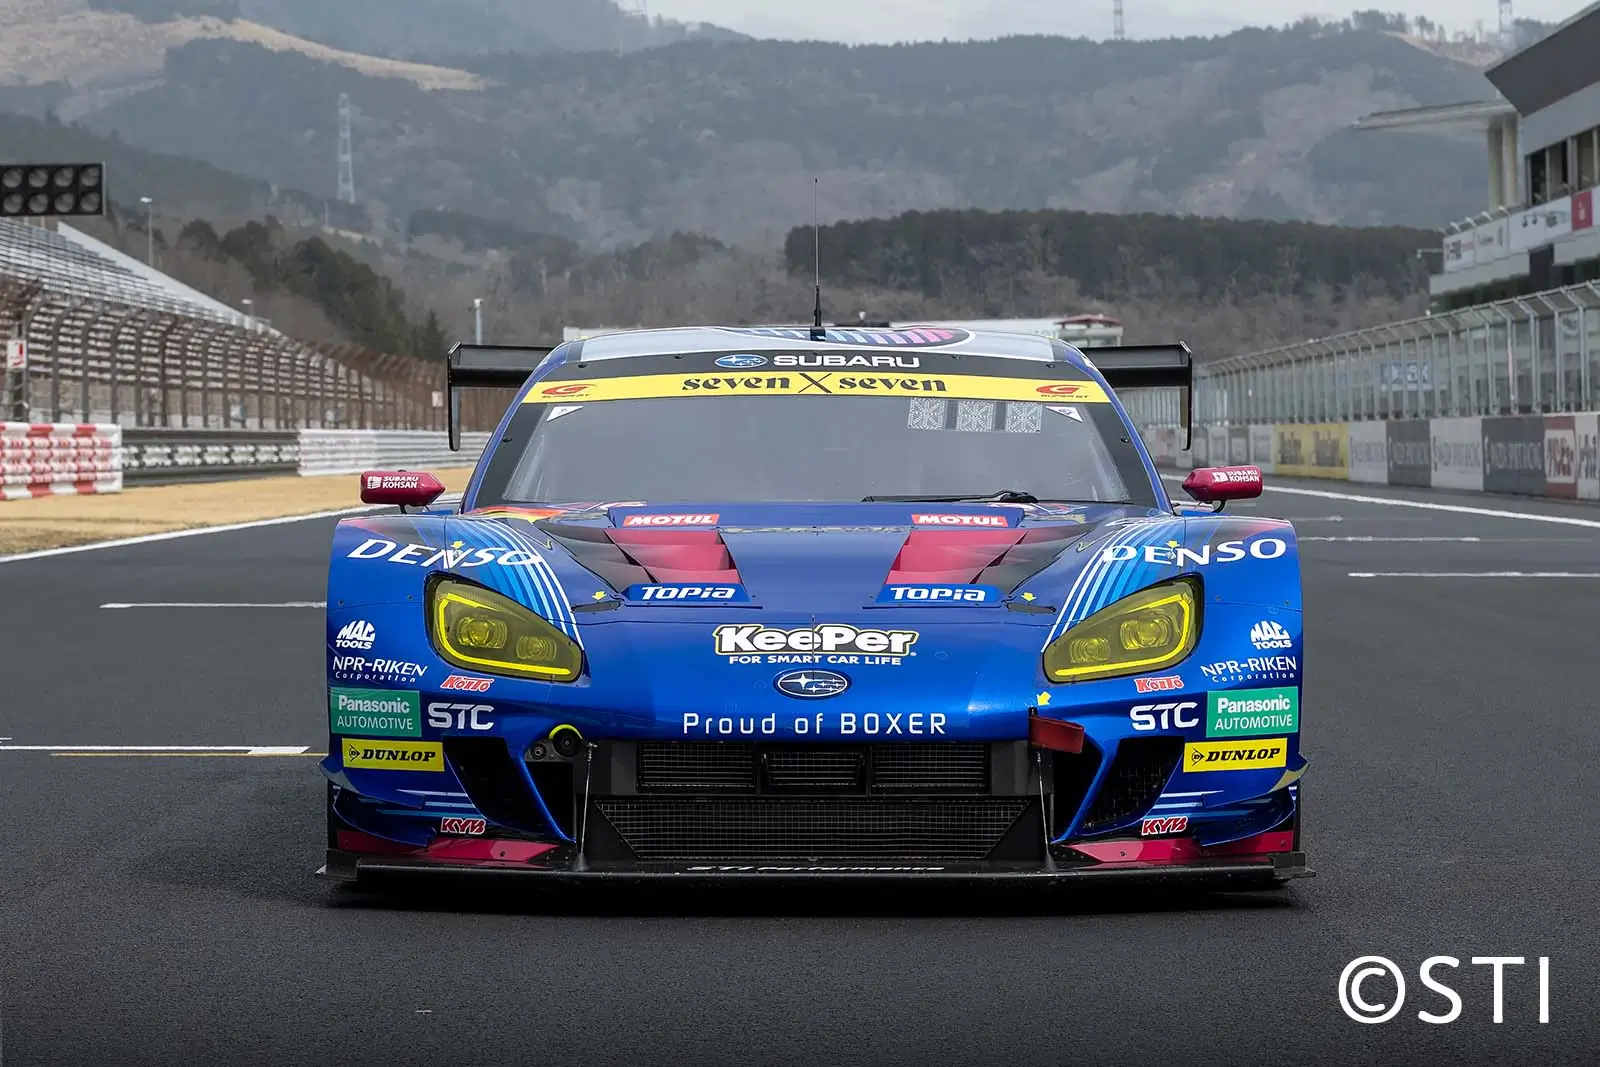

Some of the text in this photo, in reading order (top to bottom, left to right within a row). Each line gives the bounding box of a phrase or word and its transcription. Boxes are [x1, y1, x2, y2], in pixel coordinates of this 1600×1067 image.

[773, 355, 920, 368] SUBARU
[681, 376, 790, 391] seven
[838, 377, 948, 392] seven
[1229, 475, 1260, 483] KOHSAN
[627, 514, 715, 526] MOTUL
[918, 515, 1005, 526] MOTUL
[347, 538, 539, 569] DENSO
[1102, 538, 1287, 567] DENSO
[336, 620, 376, 640] MAC
[1250, 620, 1291, 641] MAC
[335, 640, 373, 649] TOOLS
[714, 624, 917, 654] KeePer
[1253, 639, 1293, 650] TOOLS
[332, 656, 428, 677] NPR-RIKEN
[729, 655, 902, 666] FOR SMART CAR LIFE
[1200, 656, 1297, 677] NPR-RIKEN
[335, 671, 416, 683] Corporation
[1211, 671, 1295, 683] Corporation
[338, 695, 410, 714] Panasonic
[1217, 694, 1291, 714] Panasonic
[337, 715, 414, 730] AUTOMOTIVE
[428, 702, 495, 730] STC
[683, 713, 946, 734] Proud of BOXER
[1130, 702, 1199, 731] STC
[1214, 714, 1293, 731] AUTOMOTIVE
[361, 748, 436, 762] DUNLOP
[1205, 748, 1281, 762] DUNLOP
[441, 817, 486, 834] KYB
[1141, 816, 1188, 835] KYB
